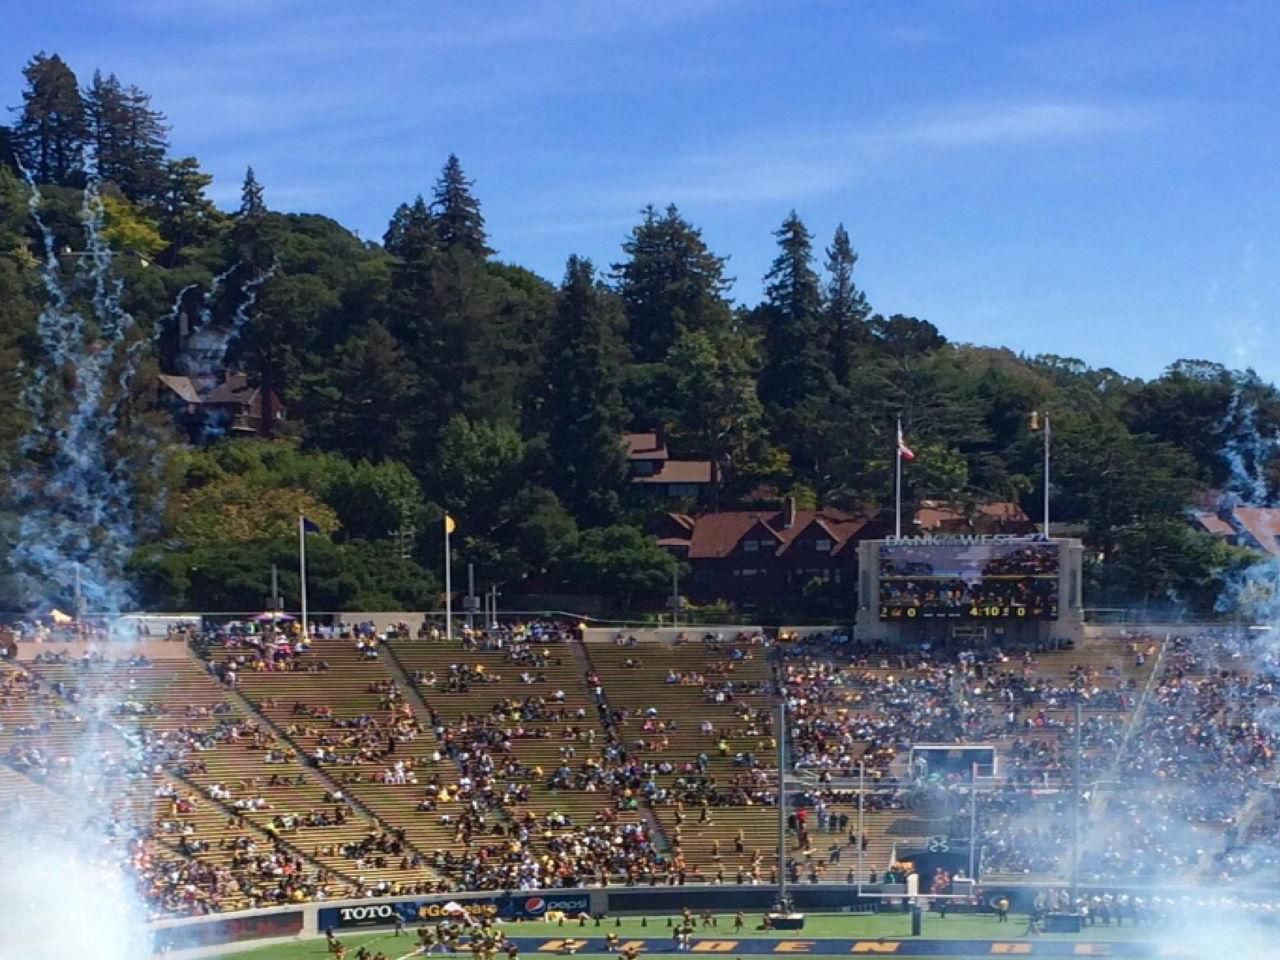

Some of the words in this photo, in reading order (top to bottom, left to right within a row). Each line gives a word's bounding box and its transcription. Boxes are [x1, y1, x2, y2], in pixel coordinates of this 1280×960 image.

[959, 534, 1017, 546] WEST
[547, 900, 588, 912] pepsi
[341, 905, 390, 920] TOTO
